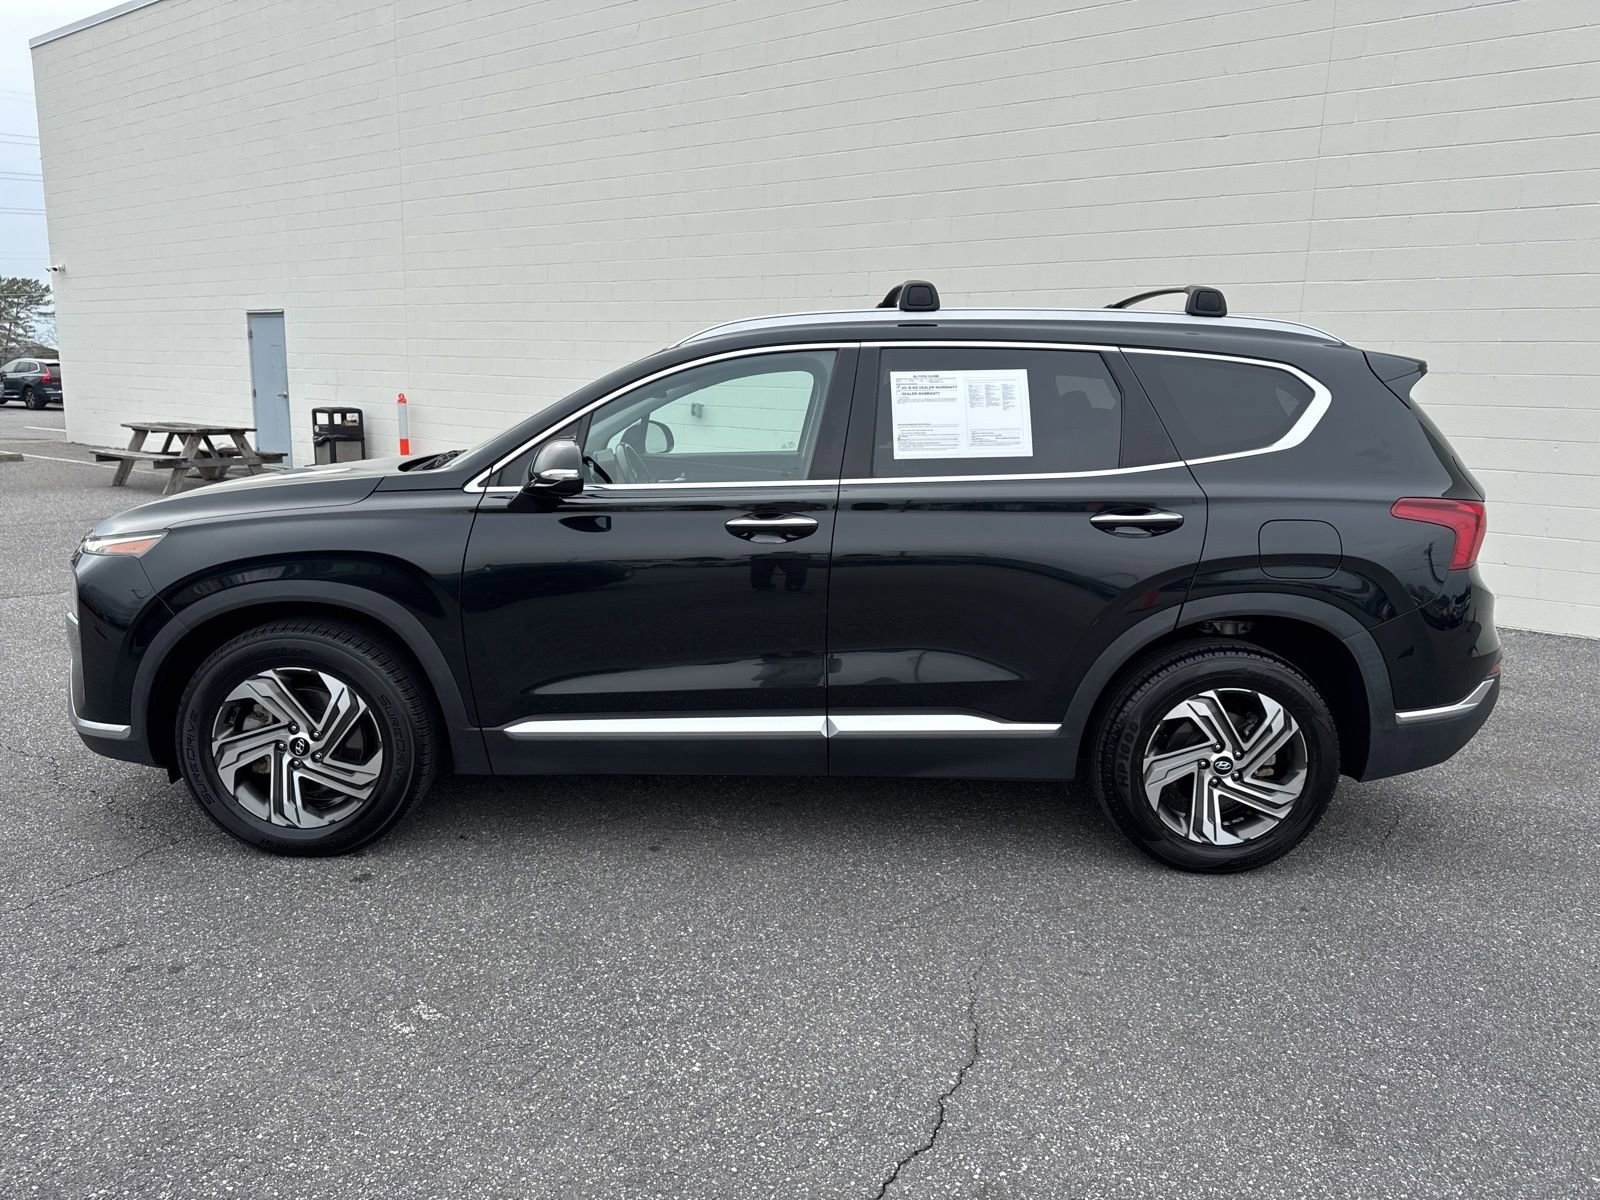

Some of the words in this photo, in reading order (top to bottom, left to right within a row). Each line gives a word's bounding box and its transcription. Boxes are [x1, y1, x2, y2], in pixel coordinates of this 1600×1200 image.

[186, 708, 215, 805] SUREDRIVE
[377, 695, 407, 787] SUREDRIVE
[1117, 720, 1139, 787] HP1000
